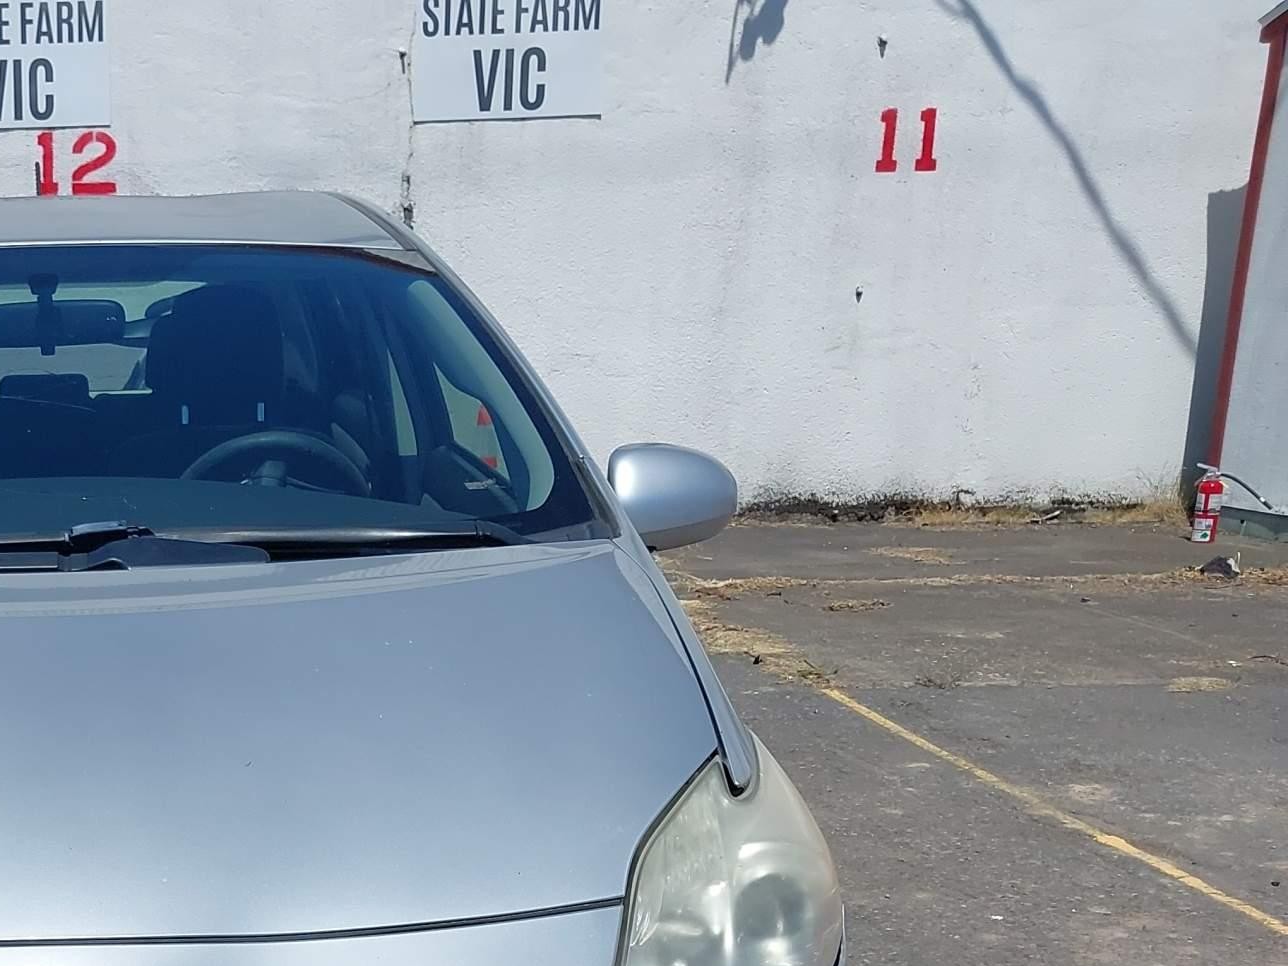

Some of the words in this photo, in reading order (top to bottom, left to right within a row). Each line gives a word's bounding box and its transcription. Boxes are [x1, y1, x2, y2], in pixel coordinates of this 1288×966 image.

[20, 1, 103, 44] FARM
[515, 0, 600, 33] FARM
[473, 47, 546, 111] VIC
[37, 131, 117, 195] 12
[875, 108, 937, 172] 11
